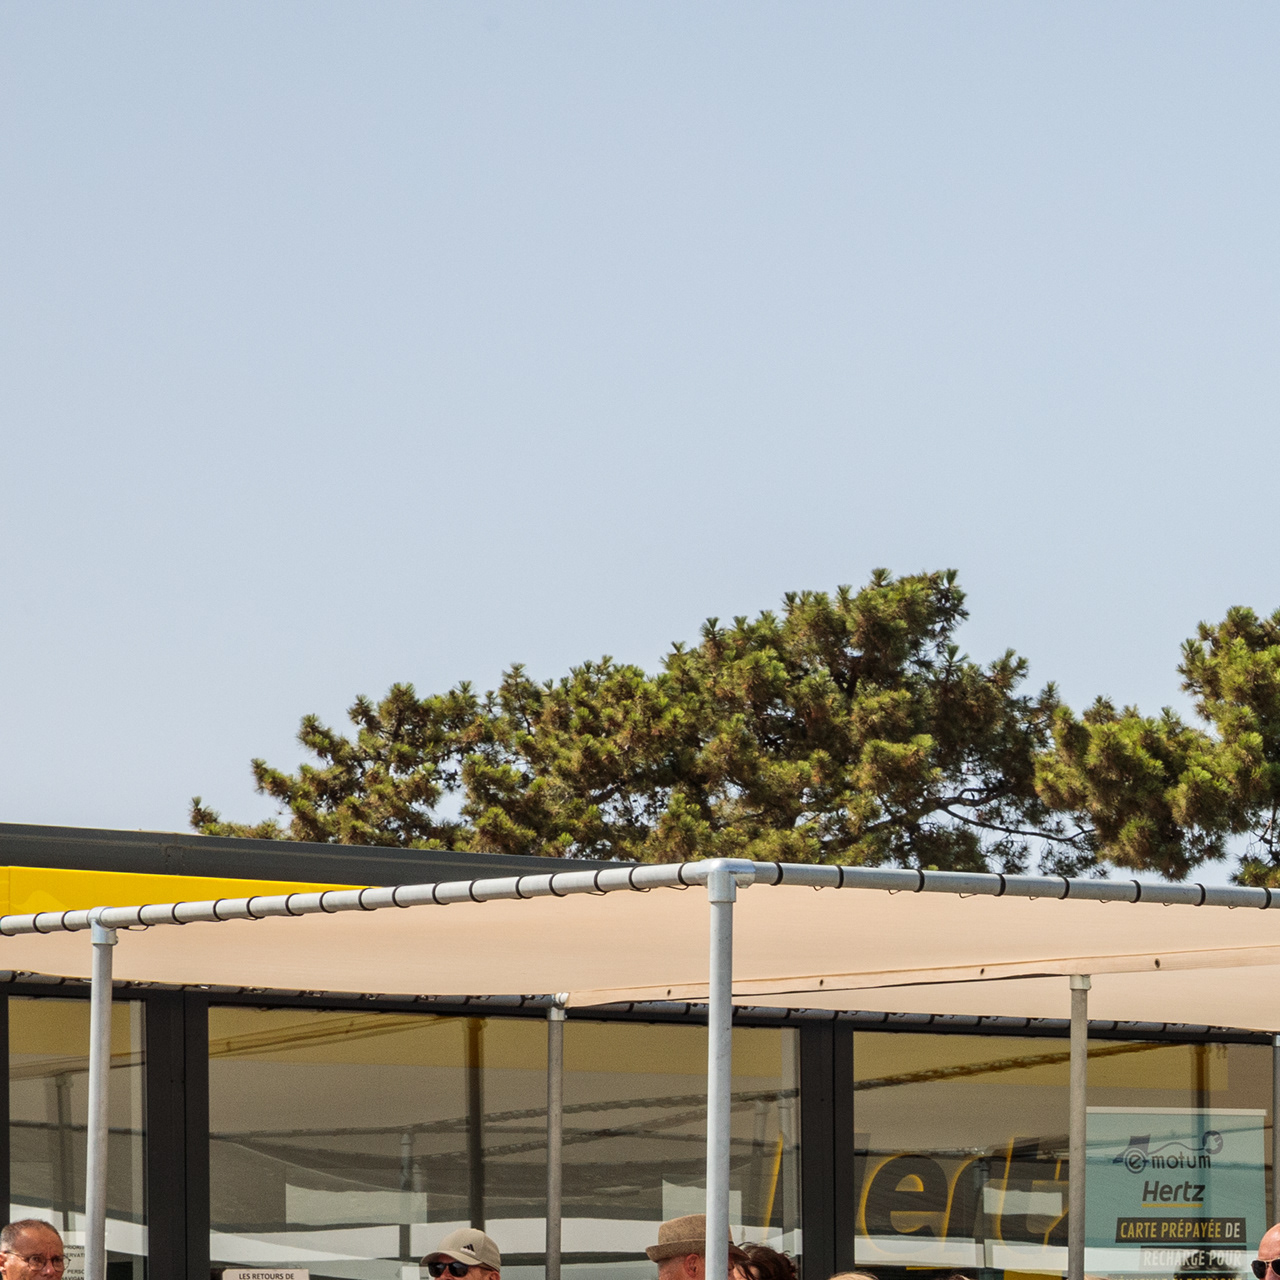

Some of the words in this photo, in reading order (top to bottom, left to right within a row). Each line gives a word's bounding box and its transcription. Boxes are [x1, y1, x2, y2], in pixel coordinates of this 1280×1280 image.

[1142, 1181, 1206, 1201] Hertz
[1120, 1221, 1157, 1238] CARTE
[1161, 1219, 1221, 1238] PRÉPAYÉE
[1225, 1222, 1241, 1238] DE
[1143, 1250, 1205, 1266] RECHARGE
[1209, 1250, 1242, 1266] POUR
